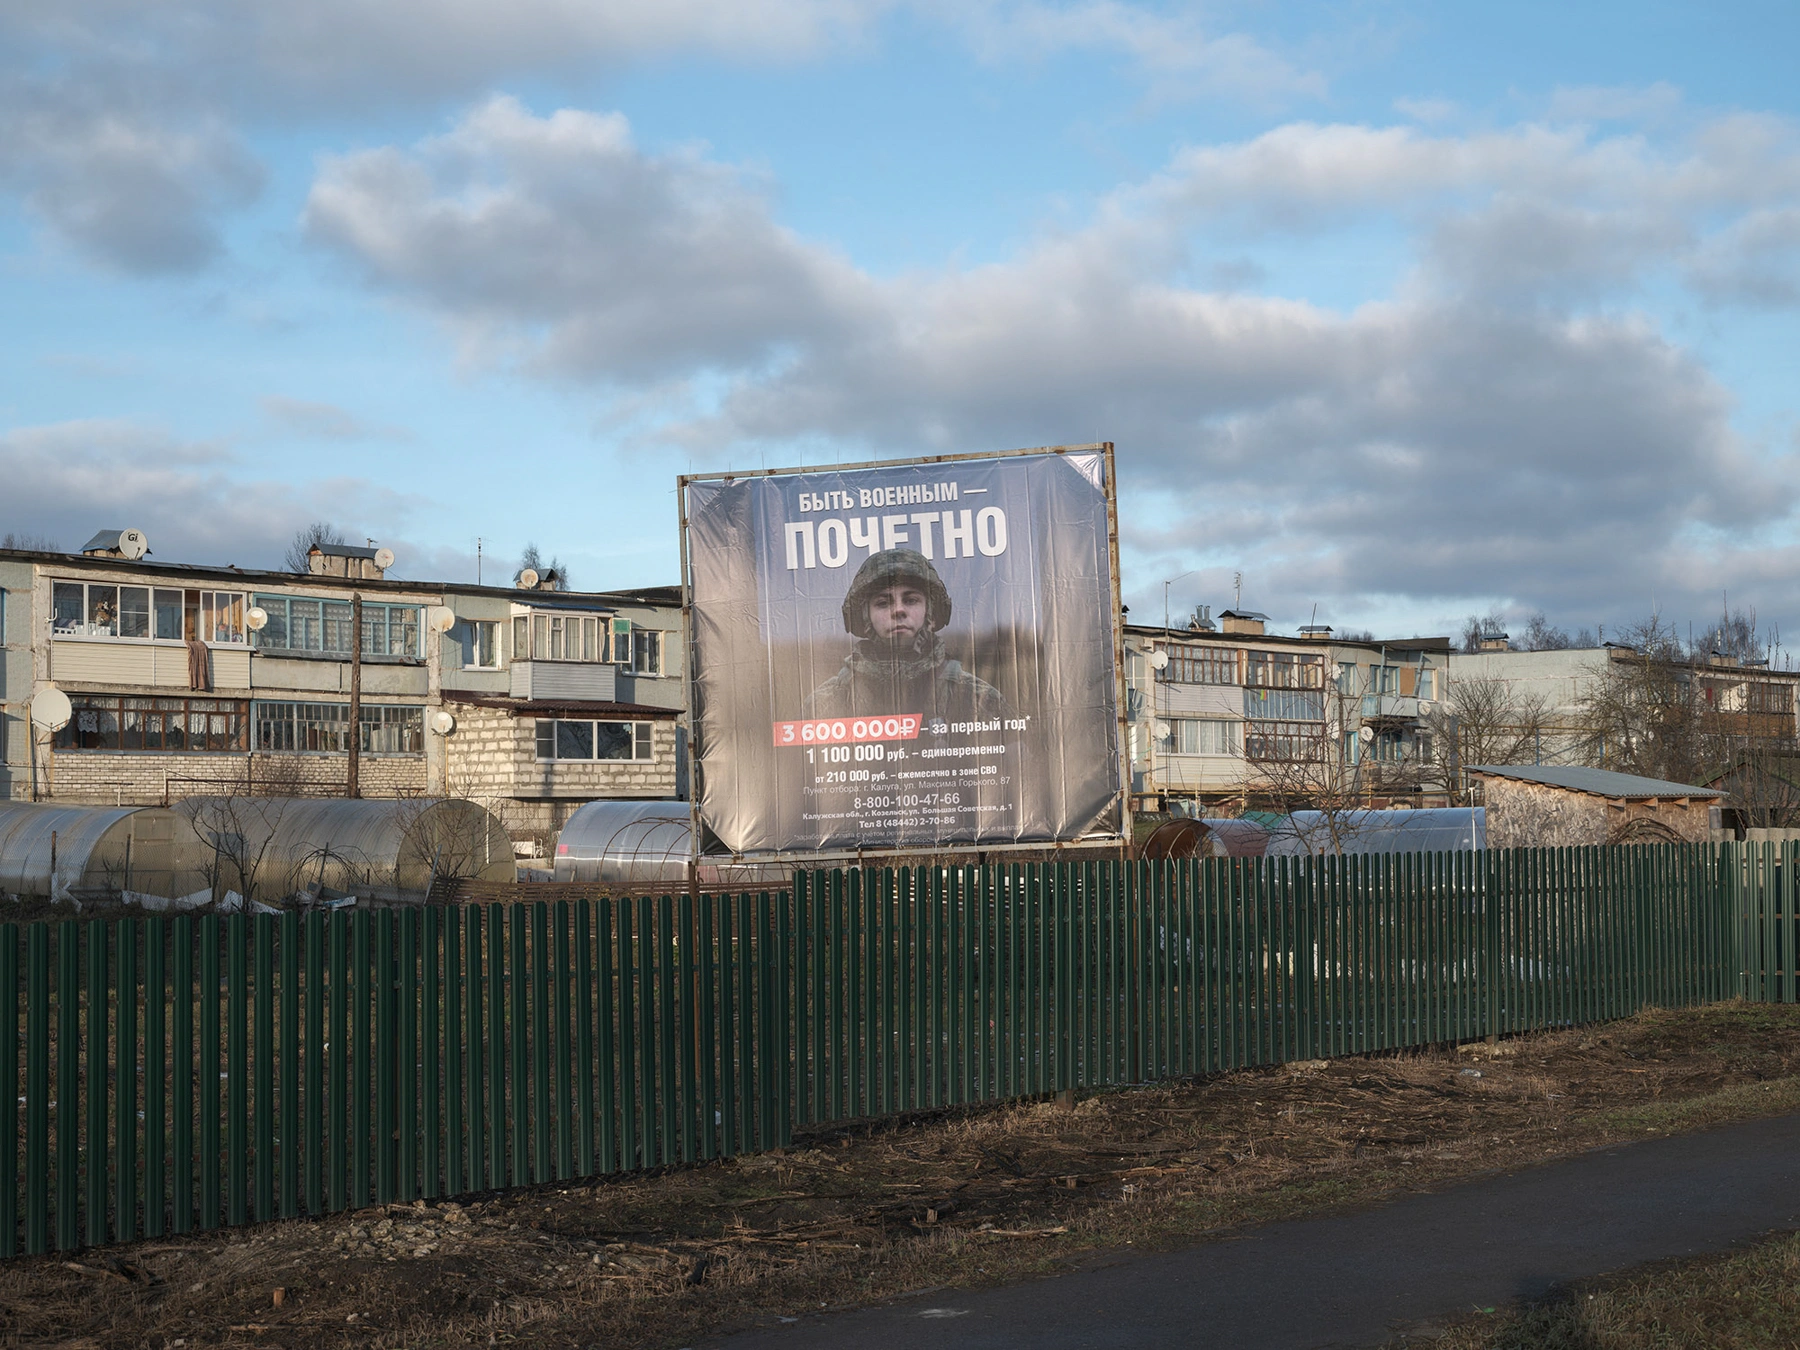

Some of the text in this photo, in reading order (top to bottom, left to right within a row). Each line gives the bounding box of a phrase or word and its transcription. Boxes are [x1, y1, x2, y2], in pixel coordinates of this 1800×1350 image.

[799, 490, 854, 513] БЫТЬ
[860, 482, 958, 508] ВОЕННЫМ
[784, 506, 1008, 570] ПОЧЕТНО
[782, 724, 795, 742] 3
[801, 721, 847, 742] 600
[932, 723, 948, 734] за
[951, 716, 1001, 735] первый
[806, 748, 814, 763] 1
[821, 746, 850, 763] 100
[854, 744, 884, 761] 000
[887, 747, 909, 762] руб.
[921, 744, 1006, 758] единовременно
[826, 771, 846, 783] 210
[849, 769, 870, 782] 000
[871, 771, 889, 782] руб.
[897, 769, 950, 779] ежемесячно
[959, 768, 979, 776] зоне
[980, 765, 997, 775] СВО
[803, 786, 827, 797] Пункт
[829, 784, 861, 794] отбора:
[903, 783, 917, 792] ул.
[918, 780, 957, 789] Максима
[1000, 776, 1011, 785] 87
[853, 792, 960, 809] 8-800-100-47-66
[802, 812, 845, 821] Калужская
[922, 807, 957, 815] Большая
[859, 816, 956, 828] Тел 8 (48442) 2-70-86
